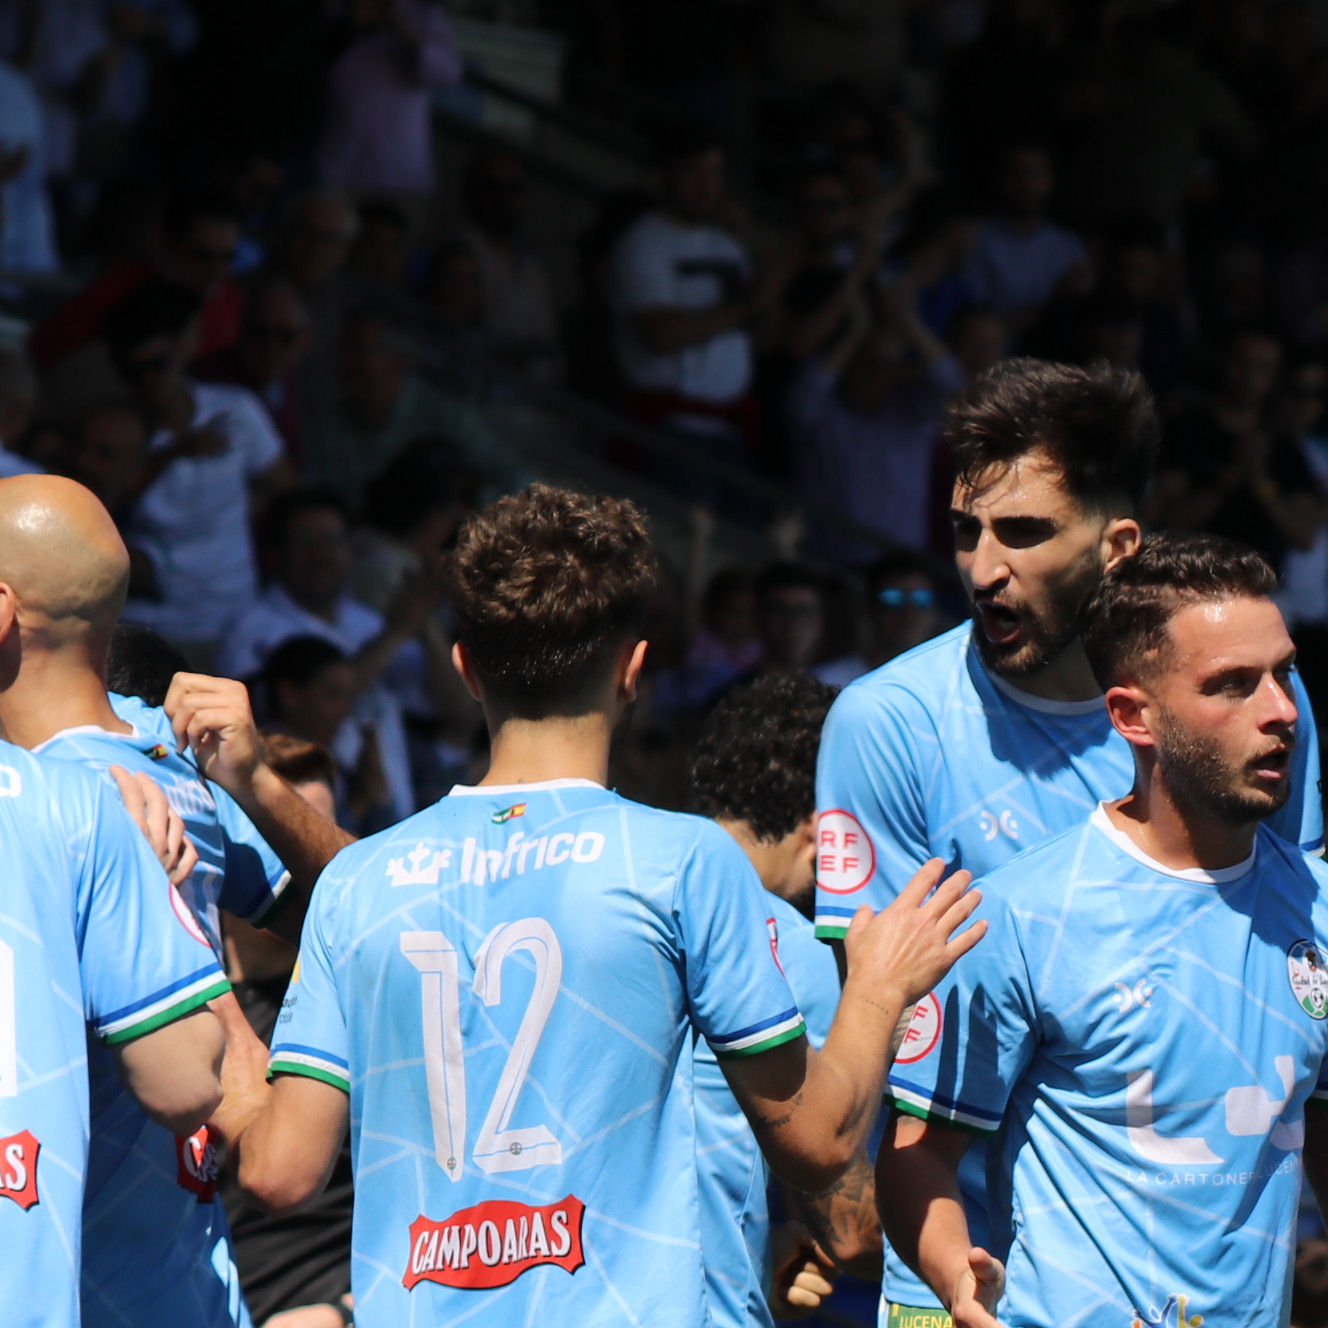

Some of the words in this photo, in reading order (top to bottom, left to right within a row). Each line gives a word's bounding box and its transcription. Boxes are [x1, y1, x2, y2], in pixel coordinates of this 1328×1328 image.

[460, 831, 605, 886] Infrico
[399, 916, 563, 1184] 12
[1127, 1171, 1149, 1184] LA
[412, 1210, 572, 1276] CAMPOARAS
